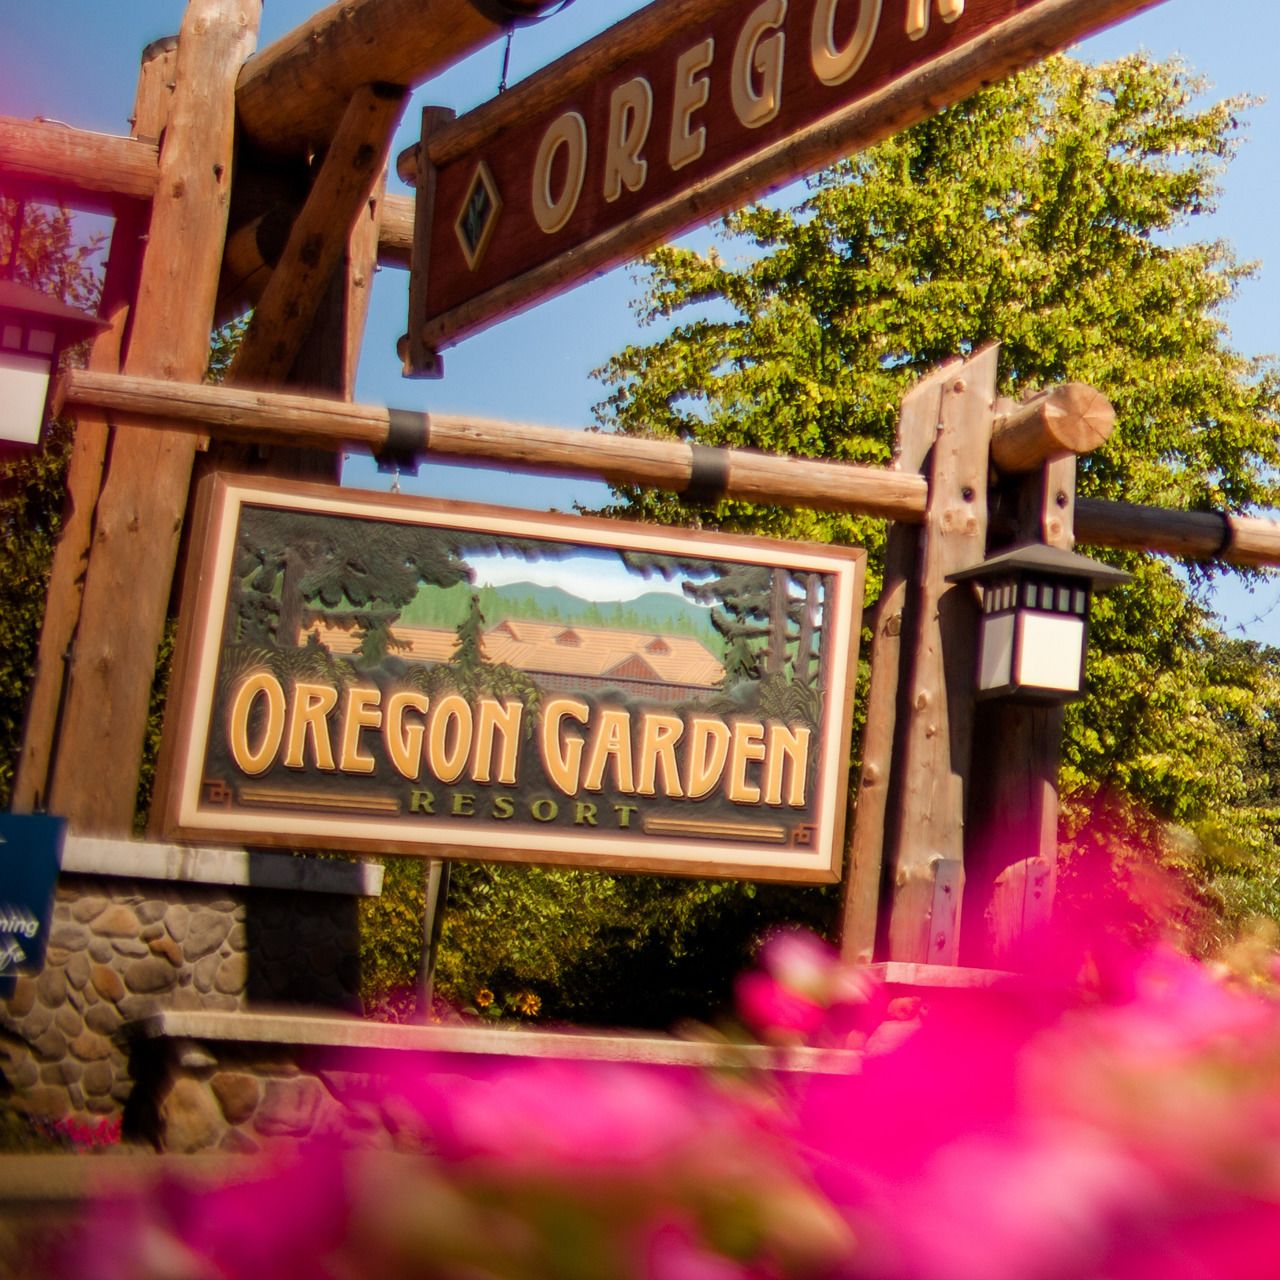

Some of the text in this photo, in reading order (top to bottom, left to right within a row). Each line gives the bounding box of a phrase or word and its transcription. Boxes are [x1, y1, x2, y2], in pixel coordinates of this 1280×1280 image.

[231, 673, 811, 807] OREGON GARDEN
[409, 790, 638, 828] RESORT
